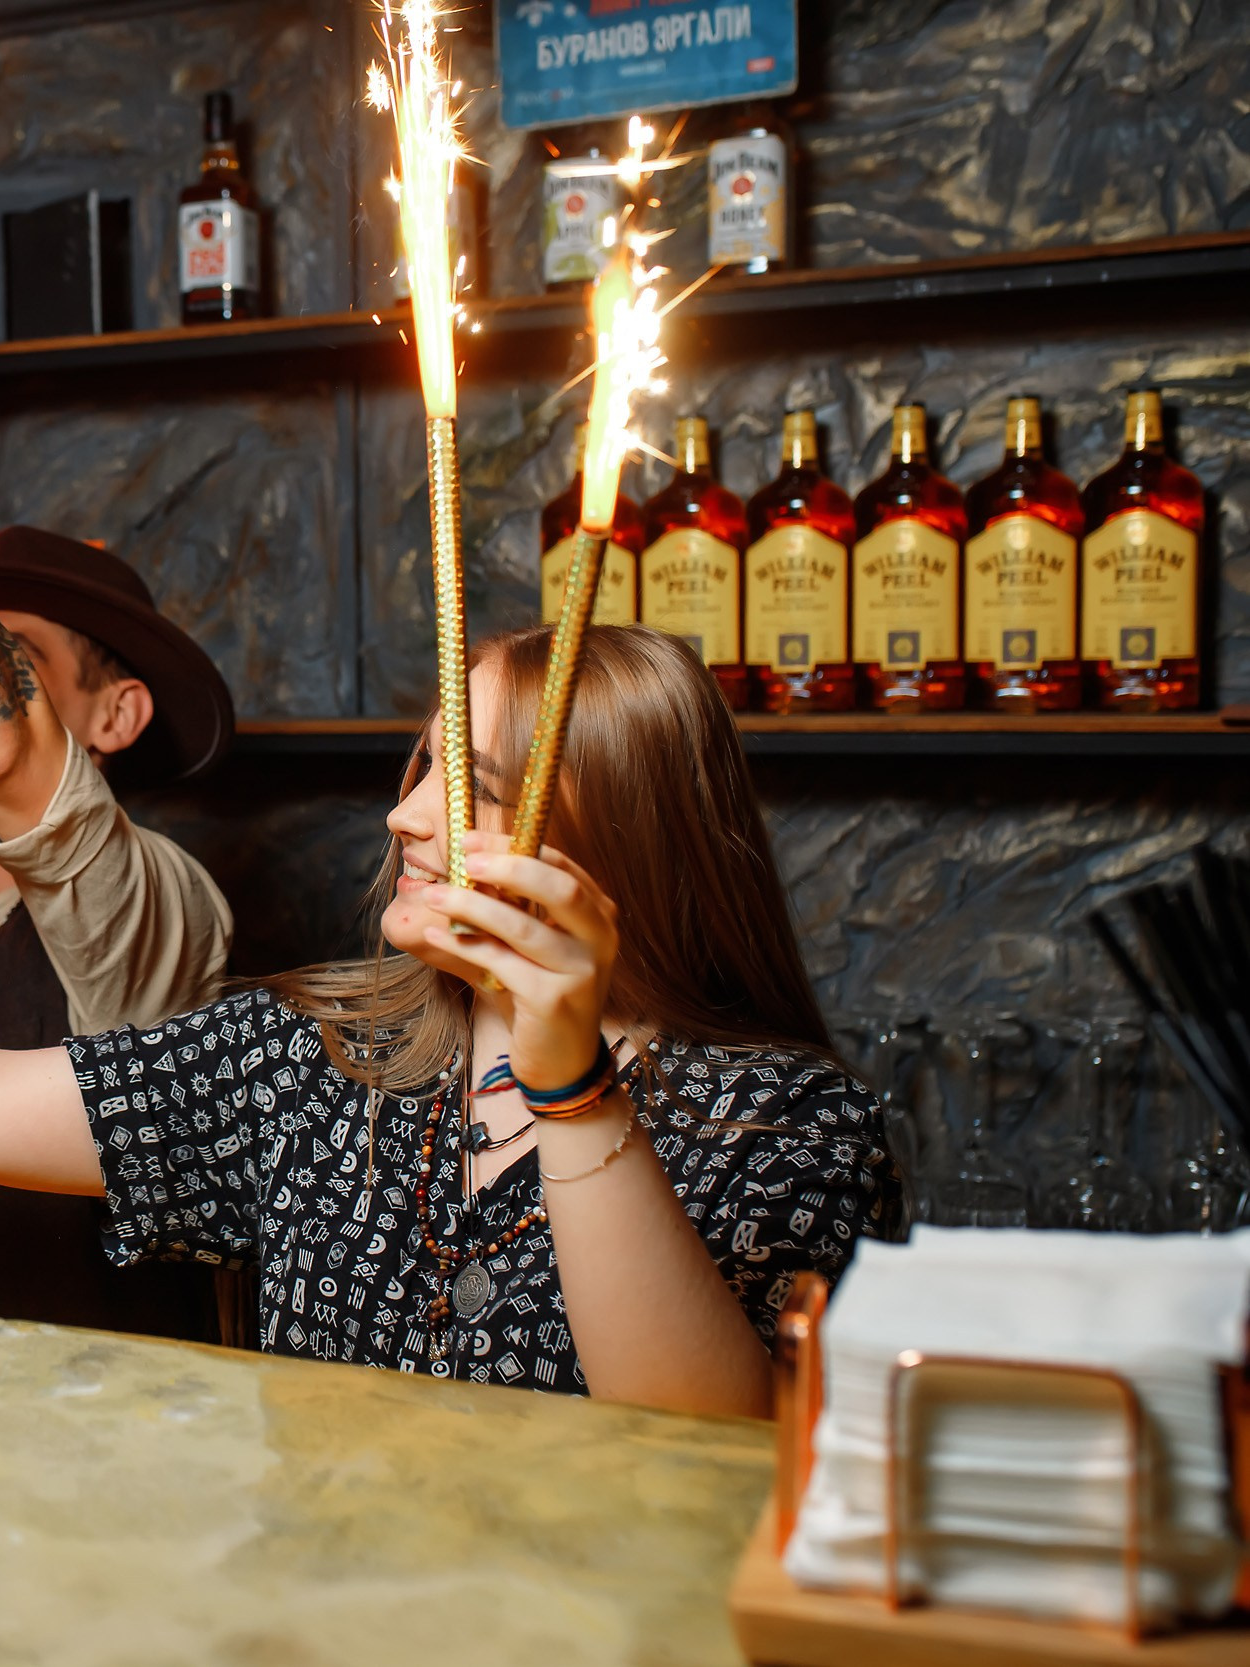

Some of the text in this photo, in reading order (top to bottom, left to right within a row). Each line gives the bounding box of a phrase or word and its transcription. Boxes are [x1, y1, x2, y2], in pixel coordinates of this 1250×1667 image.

[536, 4, 752, 71] БУРАНОВ ЭРГАЛИ
[755, 556, 836, 582] WILLIAM
[861, 551, 948, 578] WILLIAM
[975, 548, 1066, 576] WILLIAM
[1093, 544, 1185, 571] WILLIAM
[650, 558, 727, 584] WILLIAM
[881, 570, 931, 590] PEEL
[996, 569, 1049, 591] PEEL
[1114, 565, 1168, 584] PEEL
[667, 580, 713, 594] PEEL
[772, 577, 820, 593] PEEL
